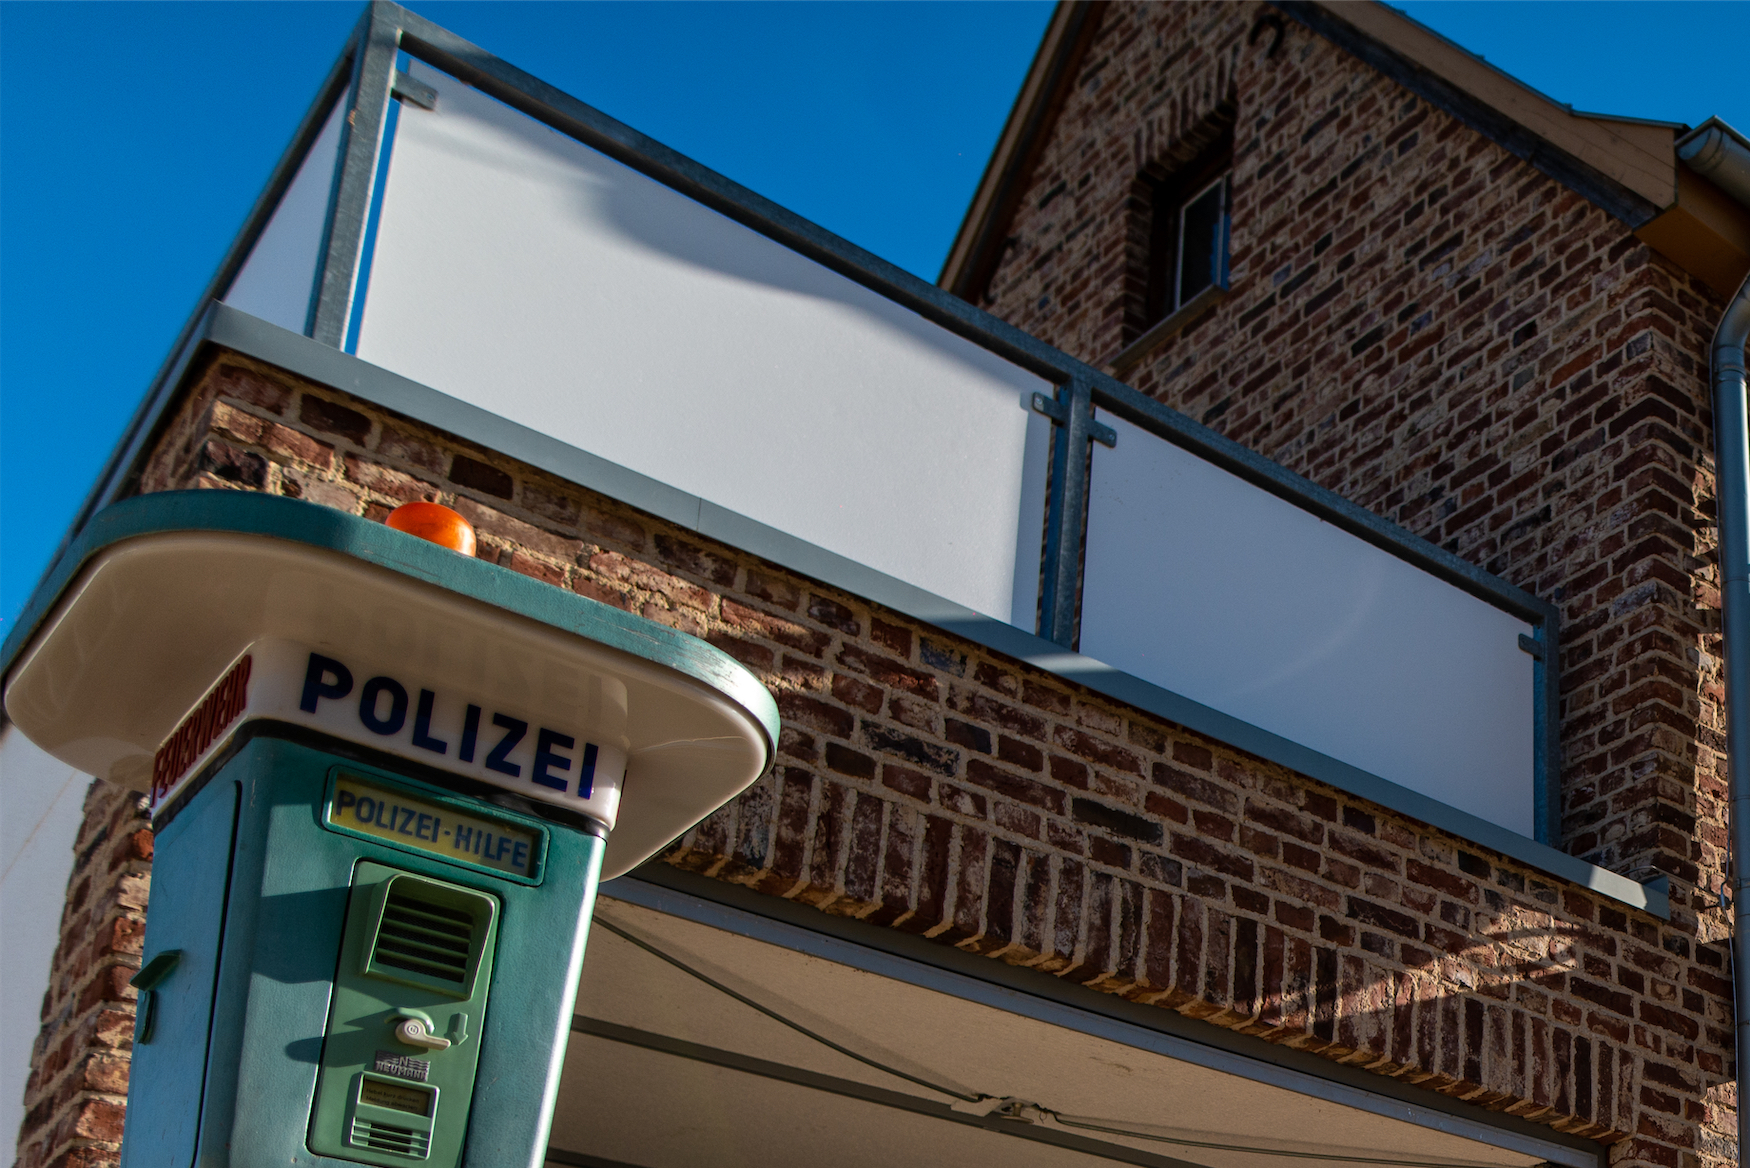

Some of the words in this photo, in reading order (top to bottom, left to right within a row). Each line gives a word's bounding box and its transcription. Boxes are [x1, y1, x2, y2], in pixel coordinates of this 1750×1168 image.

[150, 654, 252, 808] FEUERWEHR
[300, 652, 598, 800] POLIZEI
[336, 790, 529, 868] POLIZEI-HILFE
[376, 1060, 429, 1081] NEUMANN
